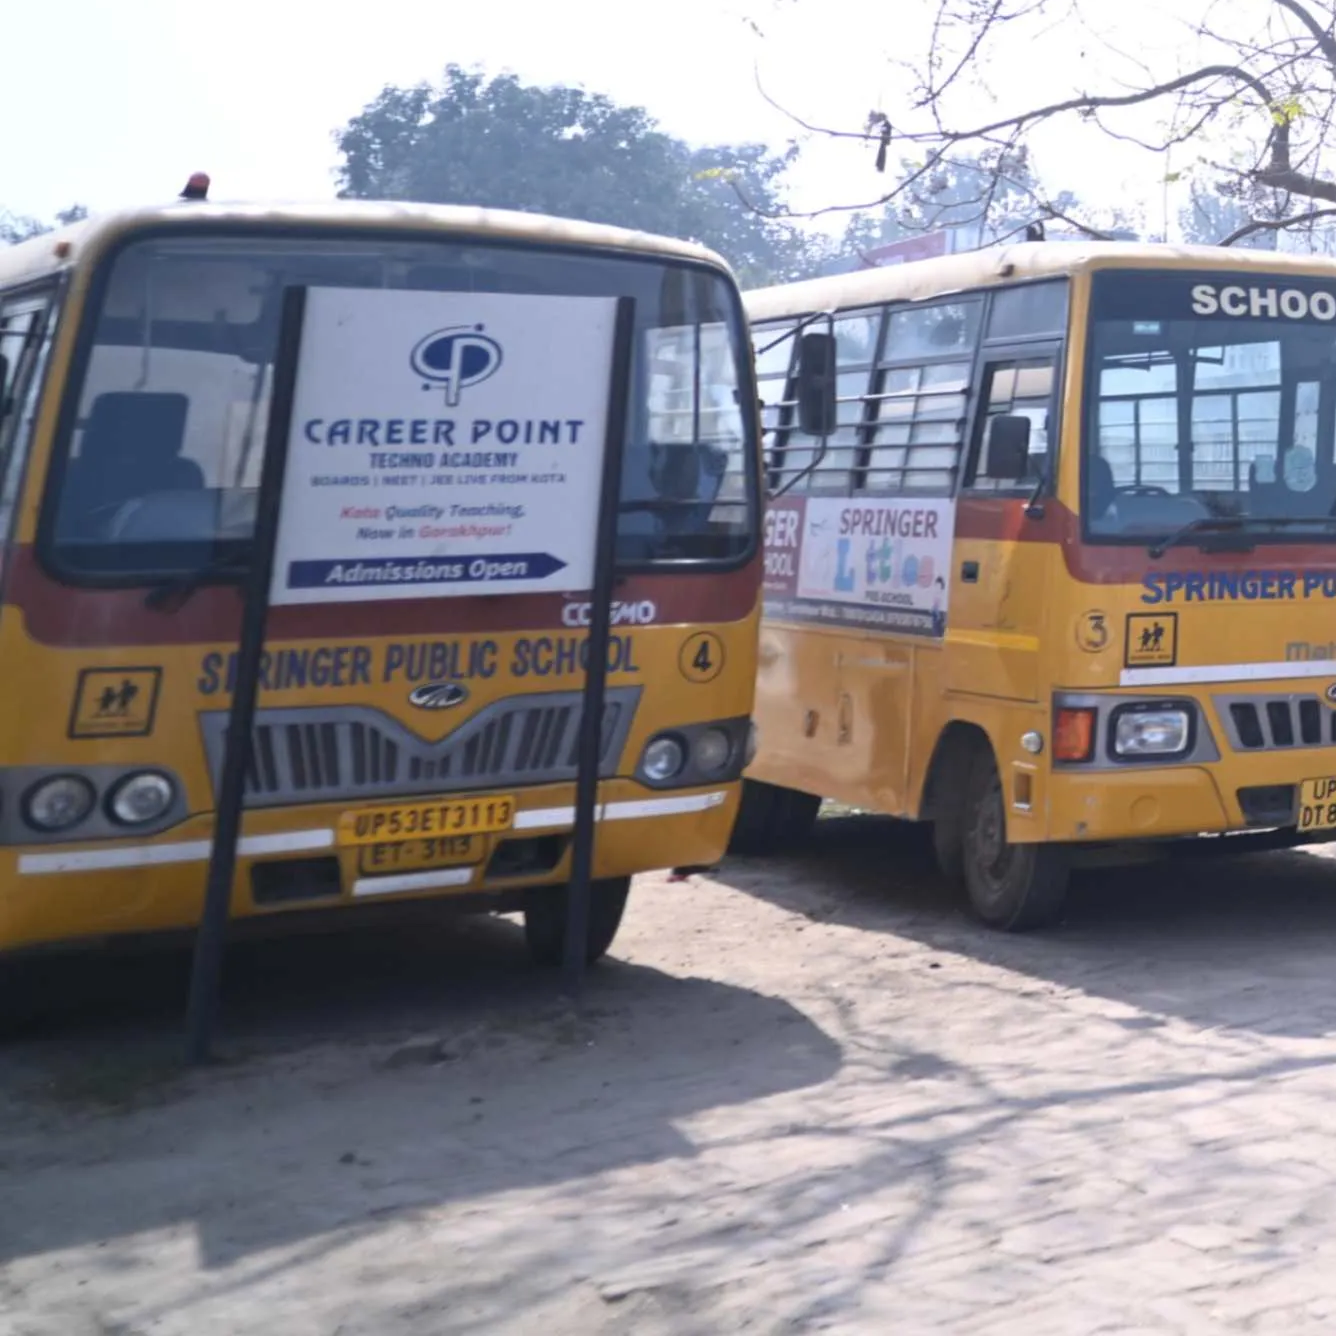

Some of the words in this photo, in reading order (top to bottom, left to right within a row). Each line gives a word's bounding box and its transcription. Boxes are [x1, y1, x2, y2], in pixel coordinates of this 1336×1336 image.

[304, 418, 457, 447] CAREER
[471, 419, 585, 445] POINT
[369, 452, 436, 470] TECHNO
[439, 451, 520, 469] ACADEMY
[839, 507, 939, 539] SPRINGER
[325, 562, 464, 584] Admissions
[468, 559, 529, 581] Open
[1140, 569, 1297, 604] SPRINGER
[1087, 614, 1108, 648] 3
[382, 639, 498, 684] PUBLIC
[691, 640, 712, 672] 4
[354, 800, 512, 837] UP53ET3113
